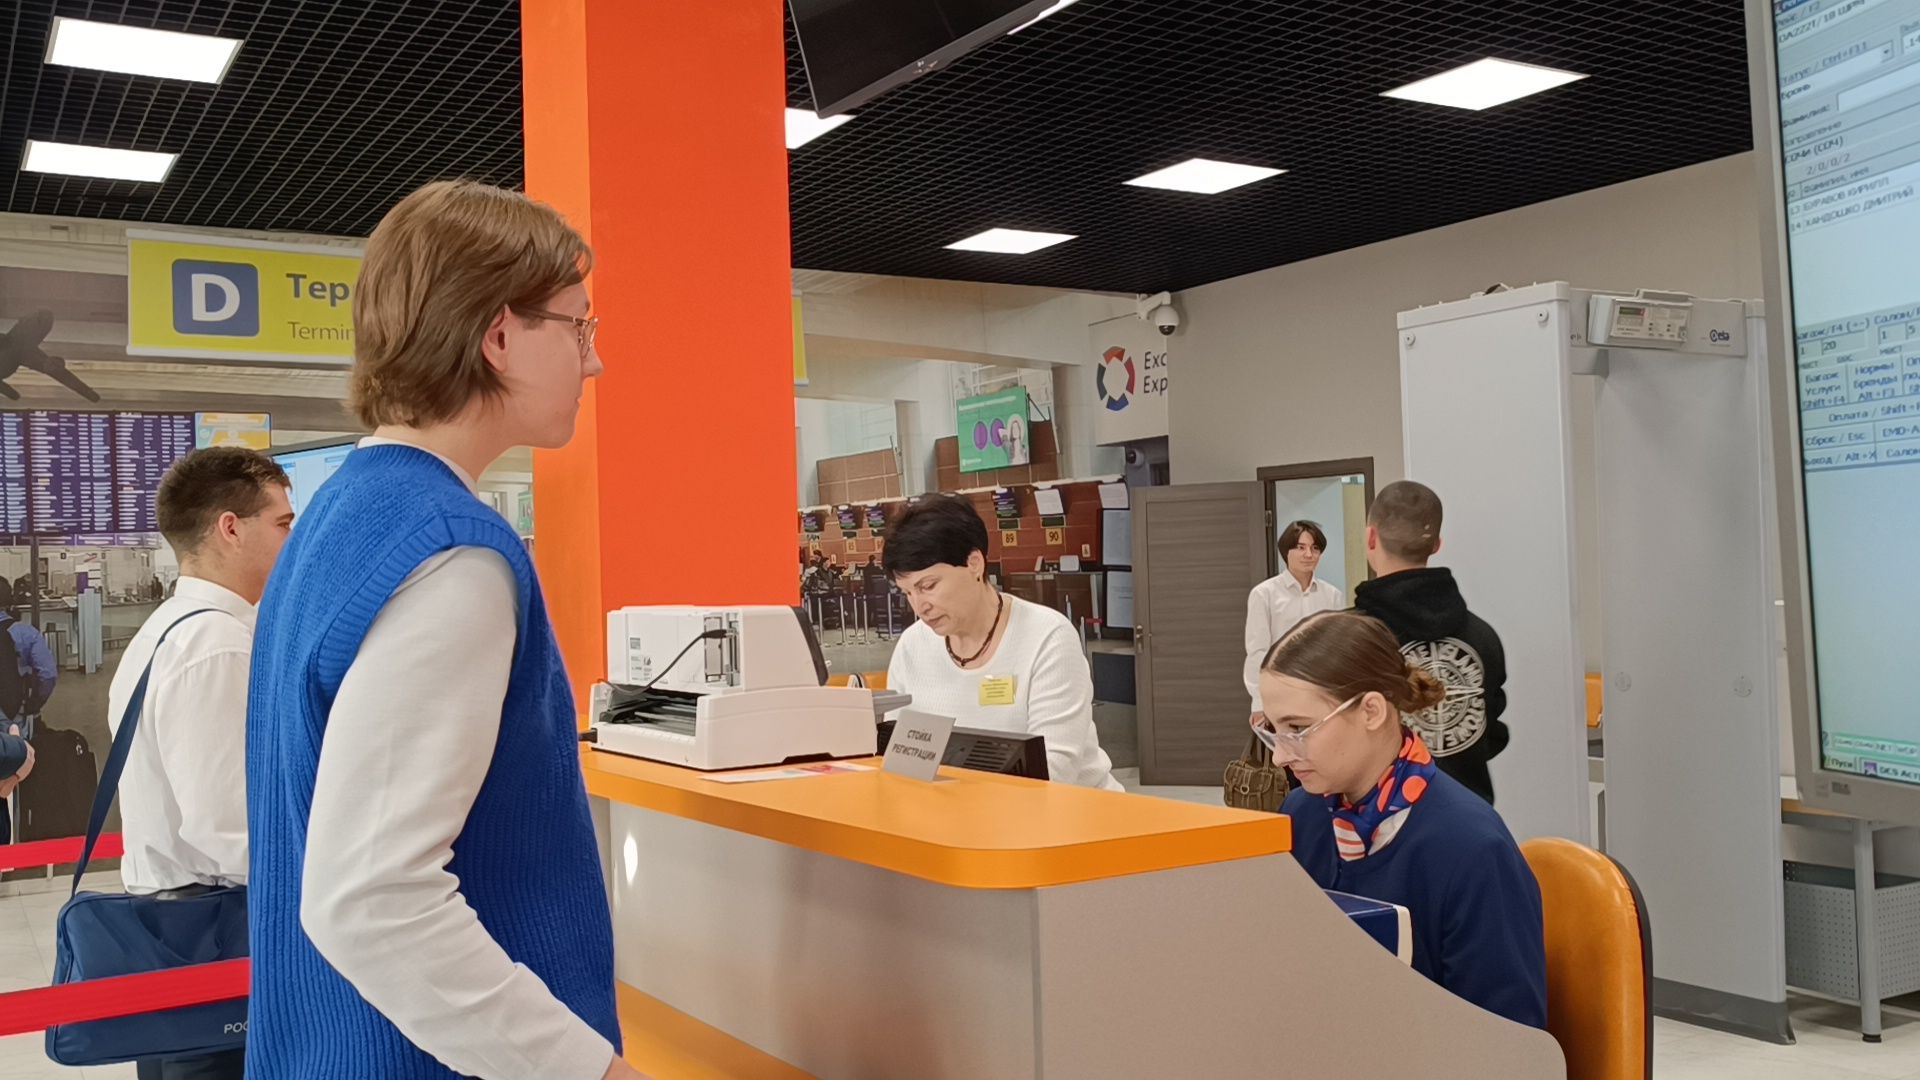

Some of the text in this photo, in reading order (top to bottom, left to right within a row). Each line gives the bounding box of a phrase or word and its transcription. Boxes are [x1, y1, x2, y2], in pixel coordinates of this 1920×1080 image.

[191, 273, 241, 322] D
[1049, 531, 1059, 542] 90
[892, 743, 937, 761] РЕГИСТРАЦИИ
